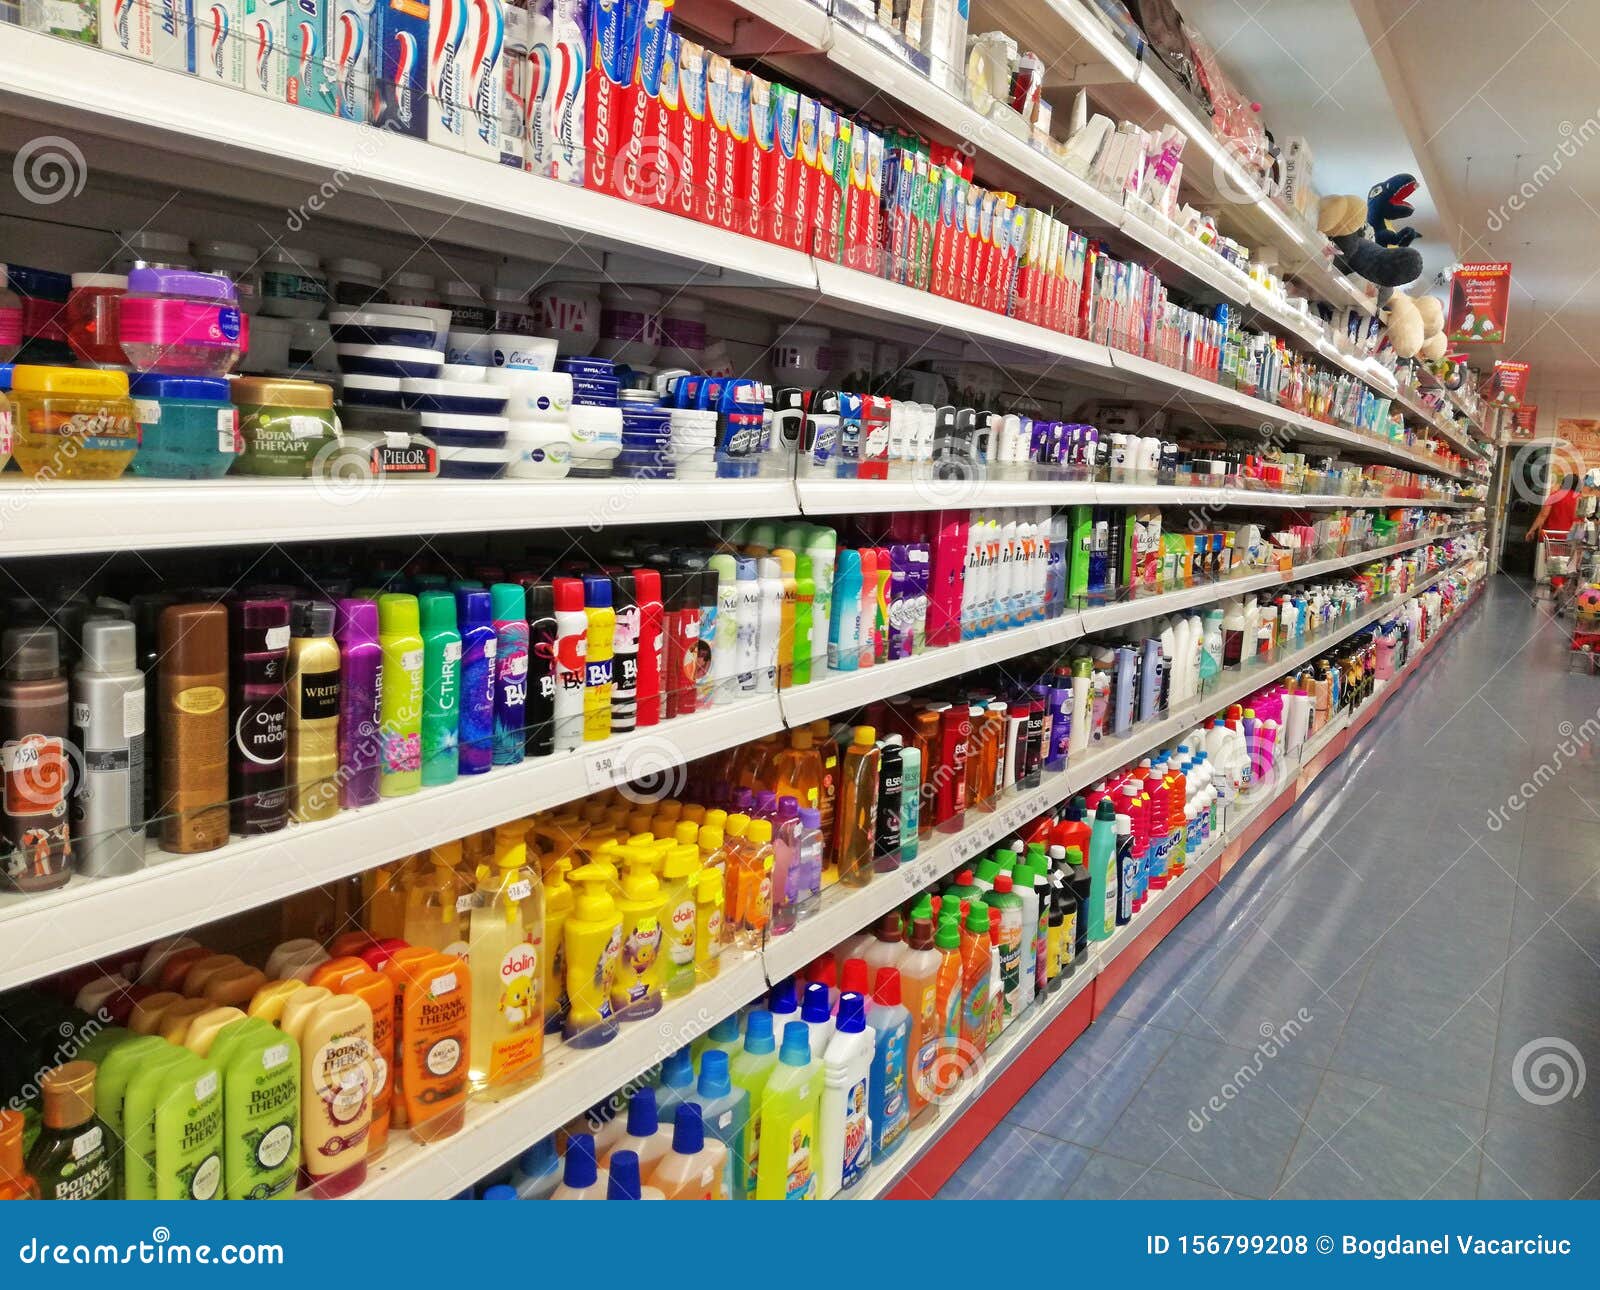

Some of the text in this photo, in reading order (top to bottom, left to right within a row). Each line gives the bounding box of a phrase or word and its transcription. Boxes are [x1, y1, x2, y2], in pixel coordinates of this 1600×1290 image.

[441, 42, 454, 133] Aquafresh
[478, 57, 492, 145] Aquafresh
[563, 91, 574, 167] Aquafresh
[592, 75, 610, 187] Colgate
[623, 90, 647, 197] Colgate
[655, 107, 668, 206] Colgate
[681, 115, 692, 212] Colgate
[705, 127, 718, 221] Colgate
[722, 136, 734, 227] Colgate
[749, 146, 761, 235] Colgate
[773, 155, 786, 240] Colgate
[794, 165, 807, 247] Colgate
[814, 173, 826, 254] Colgate
[847, 188, 859, 264] Colgate
[935, 223, 946, 291] Colgate
[509, 351, 533, 364] Care
[253, 440, 309, 453] THERAPY
[383, 449, 426, 464] PIELOR
[578, 429, 597, 437] Soft
[253, 729, 287, 744] moon
[256, 711, 286, 724] Over
[267, 723, 282, 733] the
[672, 909, 695, 924] dalin
[502, 953, 535, 976] dalin
[417, 1004, 466, 1025] THERAPY
[422, 996, 464, 1015] BOTANIC
[246, 1087, 297, 1116] THERAPY
